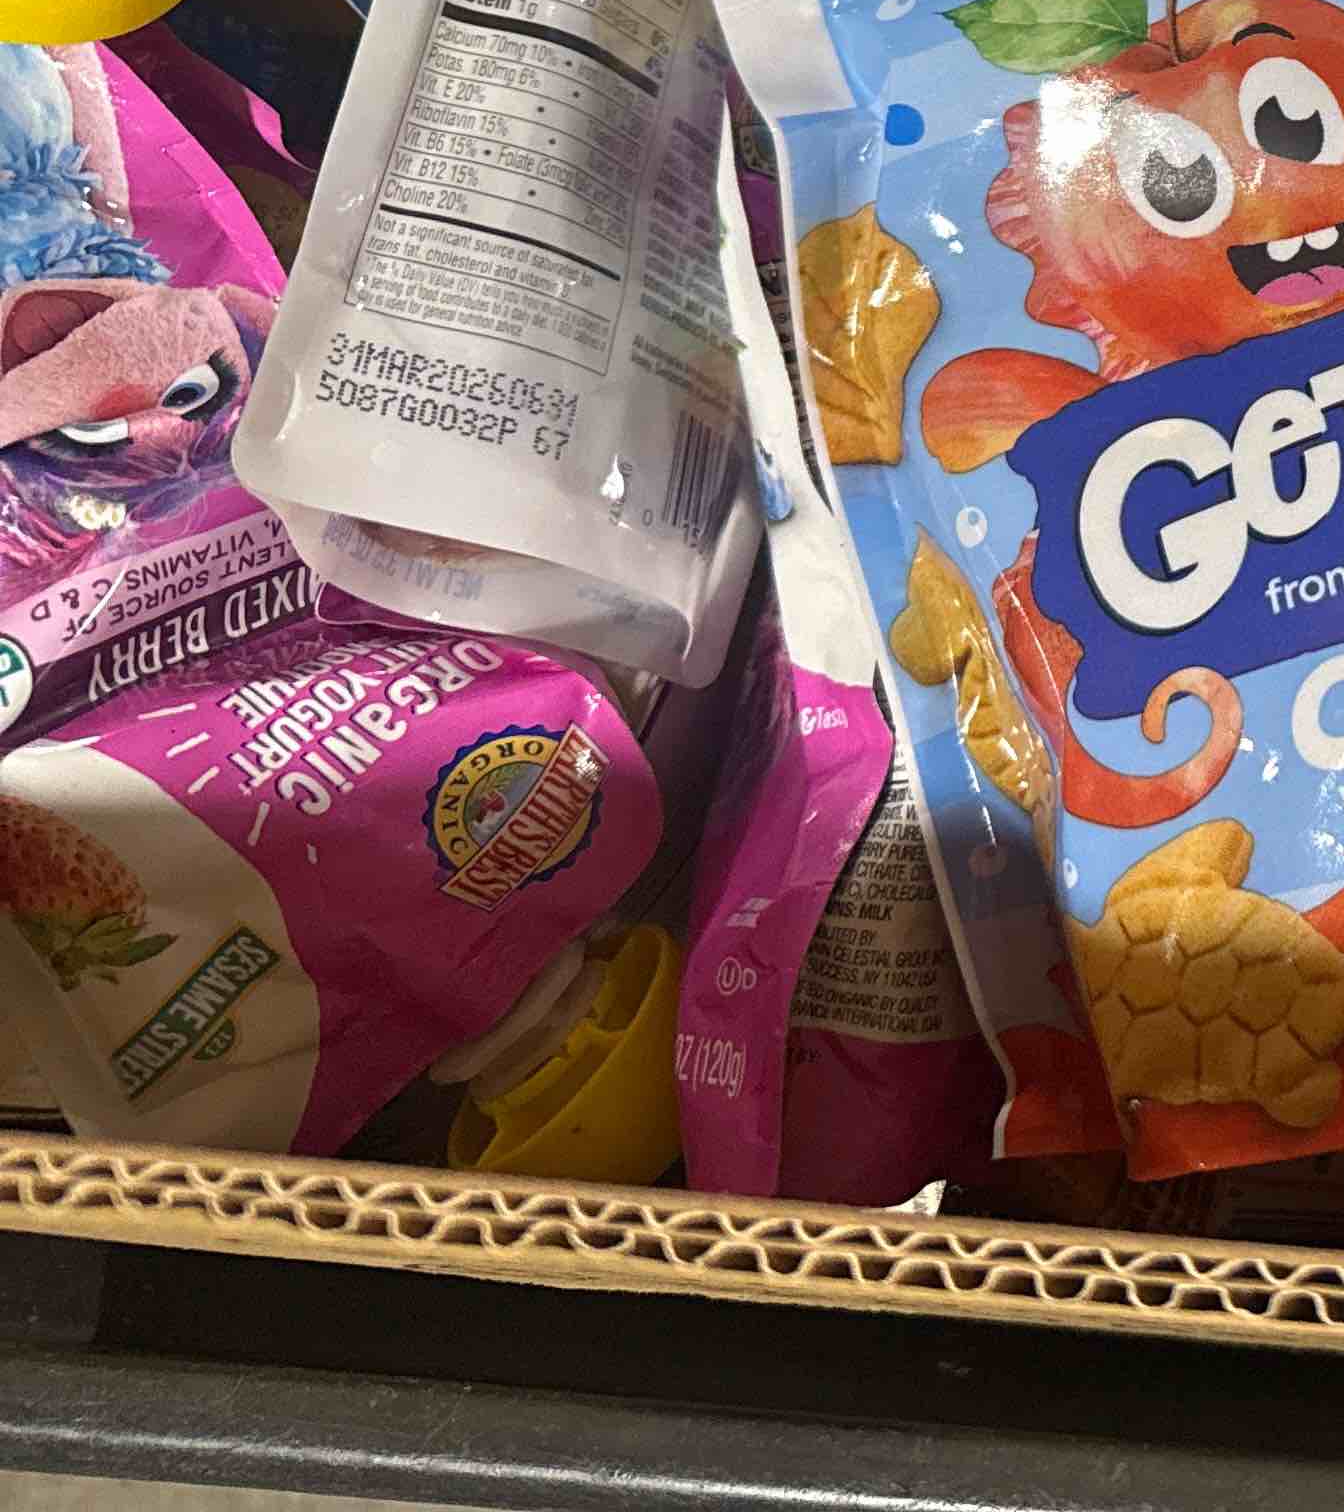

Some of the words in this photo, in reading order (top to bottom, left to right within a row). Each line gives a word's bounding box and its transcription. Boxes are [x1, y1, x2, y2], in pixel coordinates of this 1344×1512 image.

[388, 180, 436, 208] Choline
[435, 190, 470, 216] 20%
[128, 536, 255, 589] VITAMINS
[109, 566, 211, 616] SOURCE
[89, 608, 208, 702] BERRY
[430, 739, 546, 856] ORGANIC
[858, 903, 894, 924] MILK
[692, 1037, 747, 1097] (120g)
